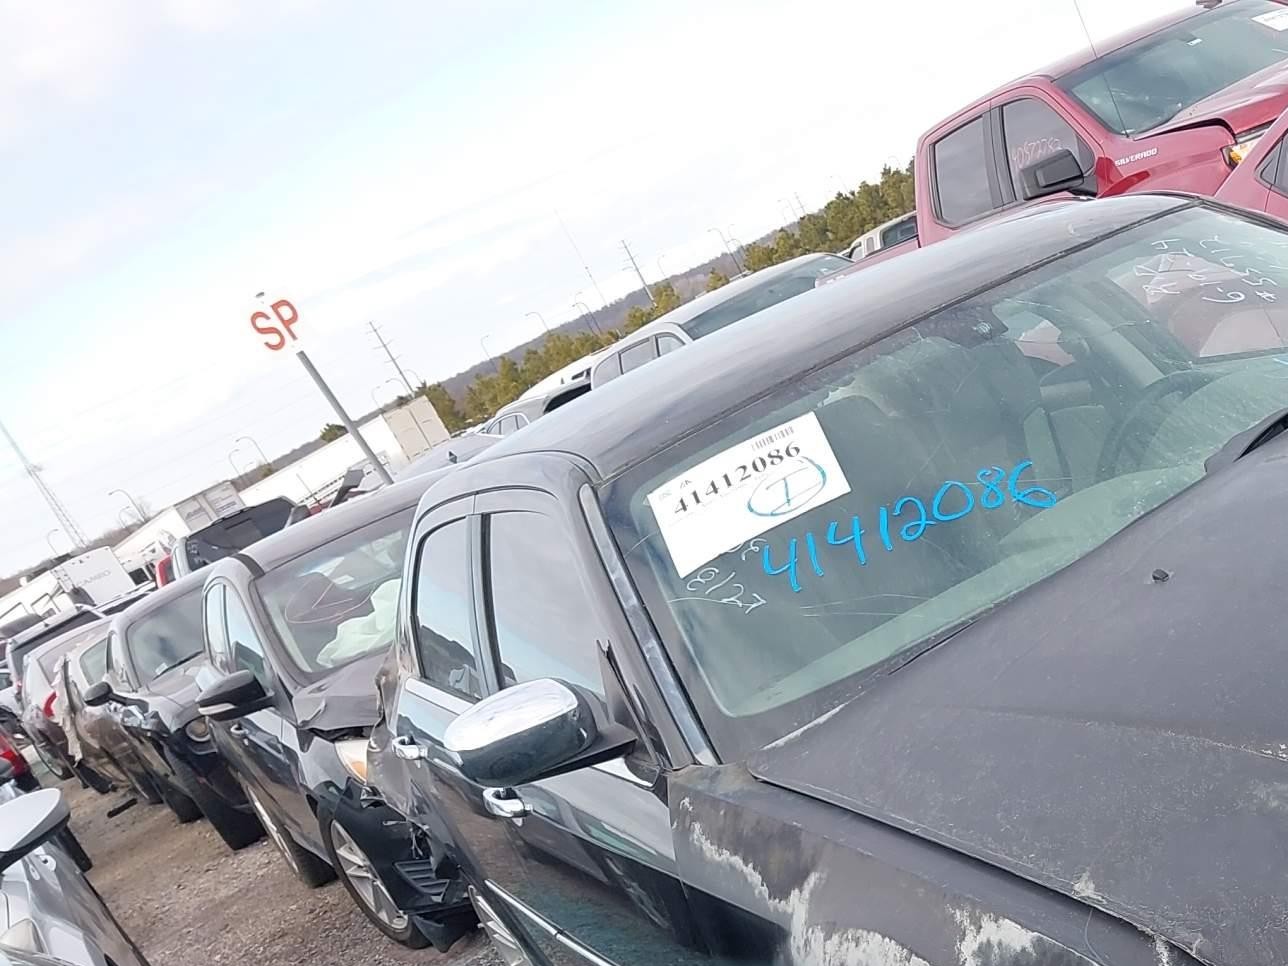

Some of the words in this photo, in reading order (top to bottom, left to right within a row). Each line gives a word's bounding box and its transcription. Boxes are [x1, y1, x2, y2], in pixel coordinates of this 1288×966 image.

[250, 299, 298, 351] SP
[674, 440, 801, 514] 41412086
[762, 460, 1057, 592] 41412086
